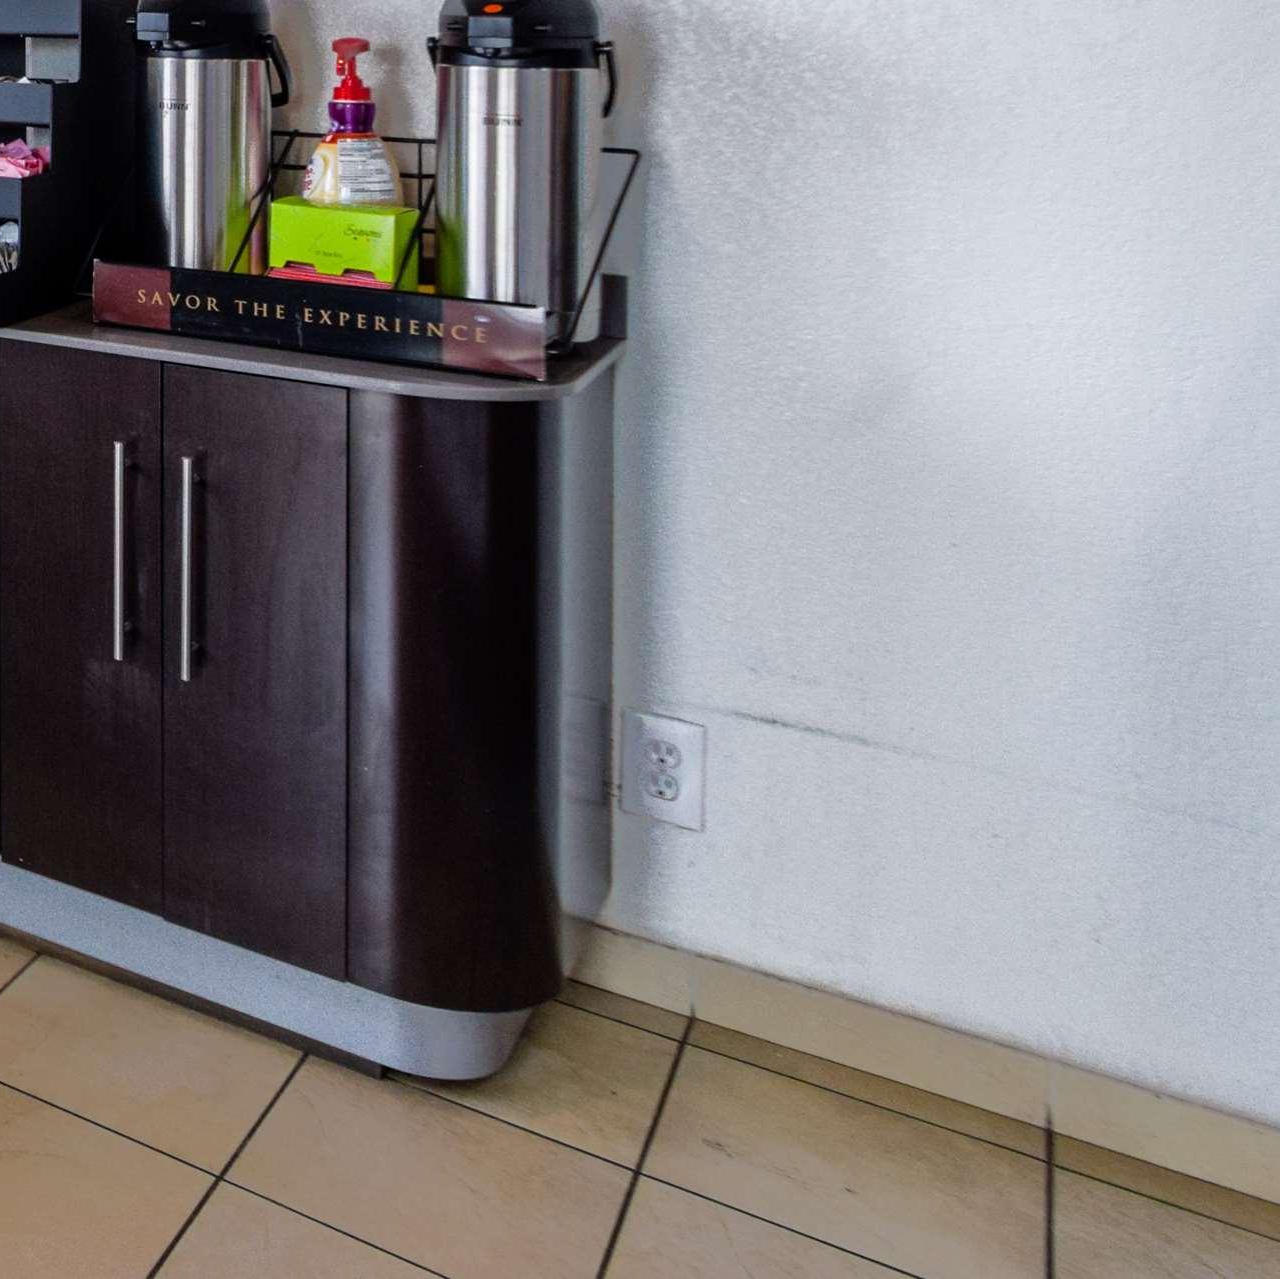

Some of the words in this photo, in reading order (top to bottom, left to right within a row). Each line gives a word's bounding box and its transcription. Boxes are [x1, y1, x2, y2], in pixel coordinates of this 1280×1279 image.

[137, 288, 220, 313] SAVOR
[234, 299, 286, 320] THE
[303, 307, 488, 344] EXPERIENCE
